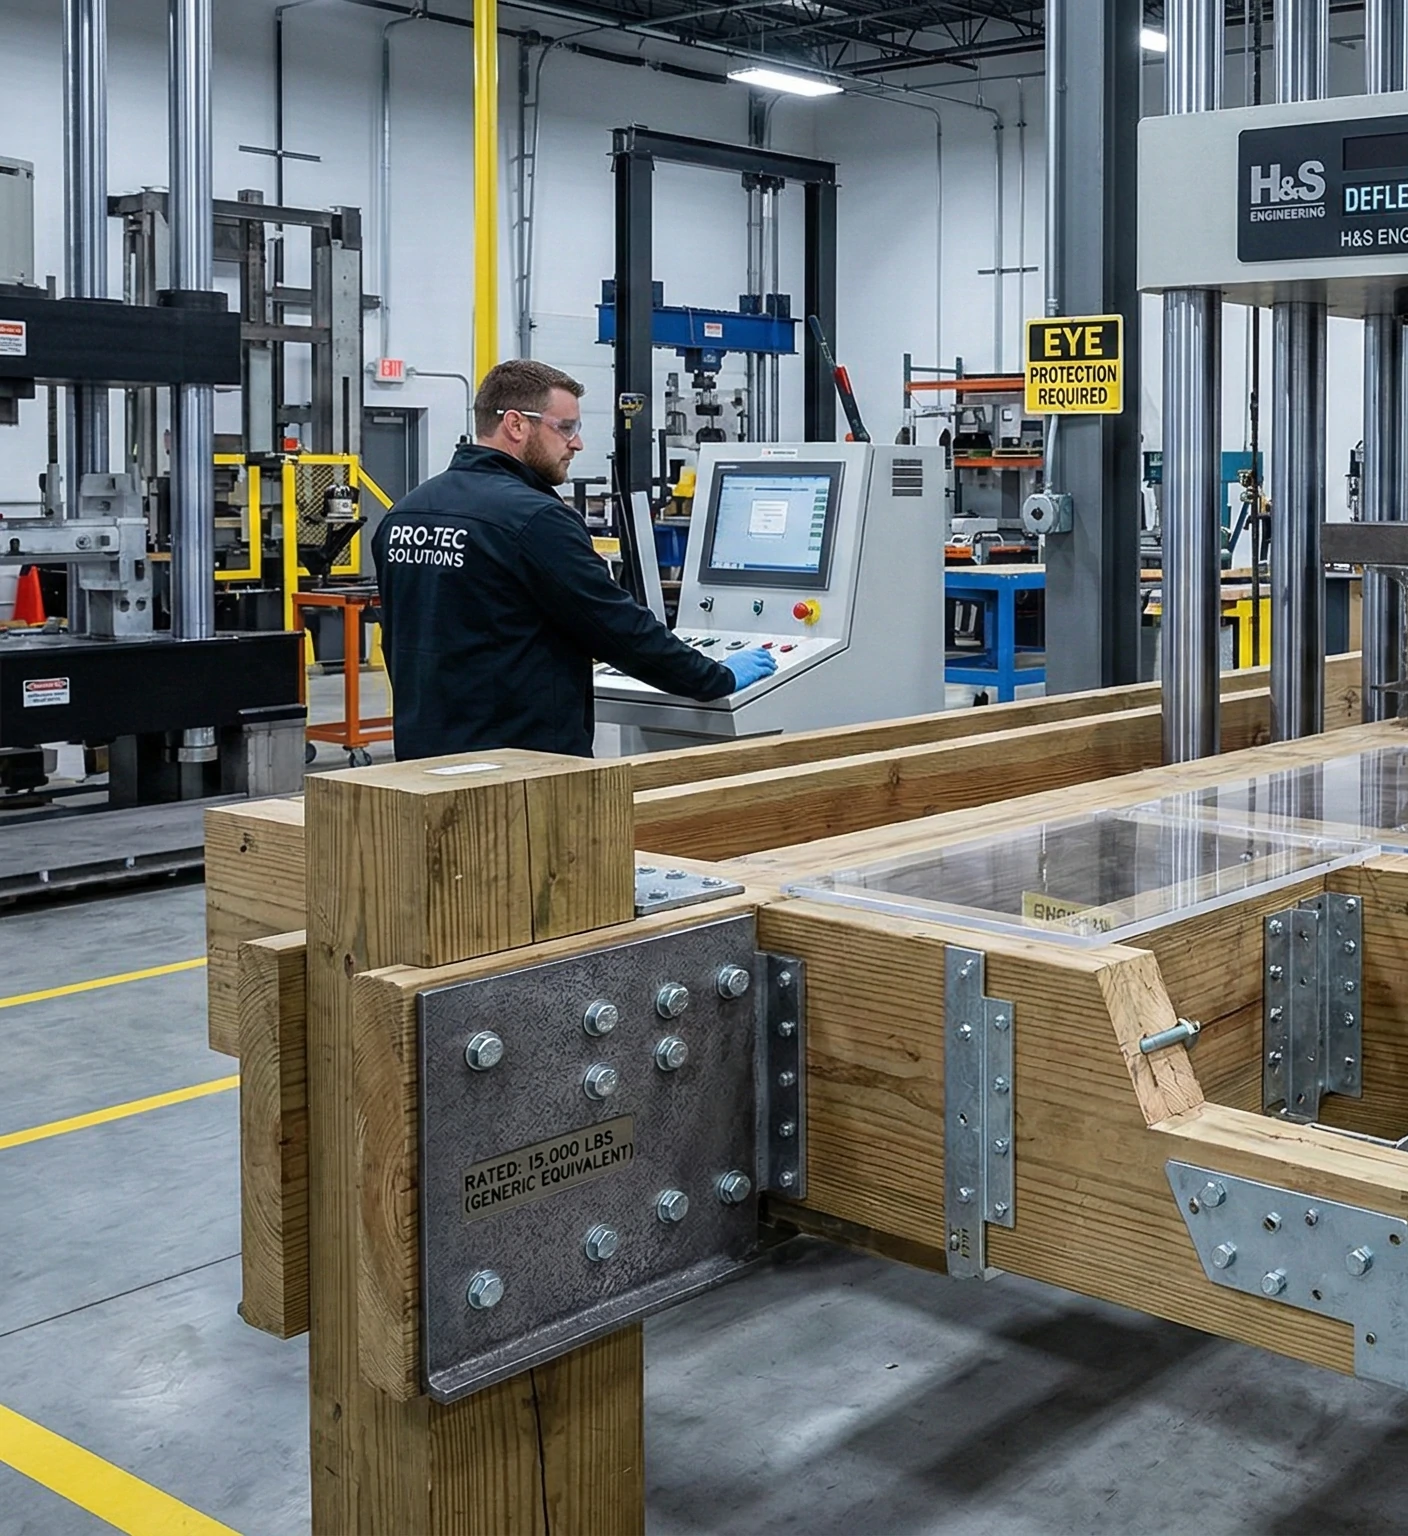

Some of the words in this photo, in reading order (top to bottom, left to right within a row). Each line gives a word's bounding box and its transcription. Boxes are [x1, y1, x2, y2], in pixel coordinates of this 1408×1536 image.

[1250, 160, 1326, 204] H&S
[1250, 206, 1325, 222] ENGINEERING
[1340, 229, 1373, 247] H&S
[1044, 326, 1103, 357] EYE
[1030, 364, 1117, 384] PROTECTION
[1038, 387, 1108, 408] REQUIRED
[389, 525, 468, 549] PRO-TEC
[388, 548, 464, 568] SOLUTIONS
[465, 1161, 522, 1192] RATED:
[585, 1130, 613, 1153] LBS
[465, 1175, 536, 1213] (GENERIC
[541, 1142, 634, 1187] EQUIVALENT)
